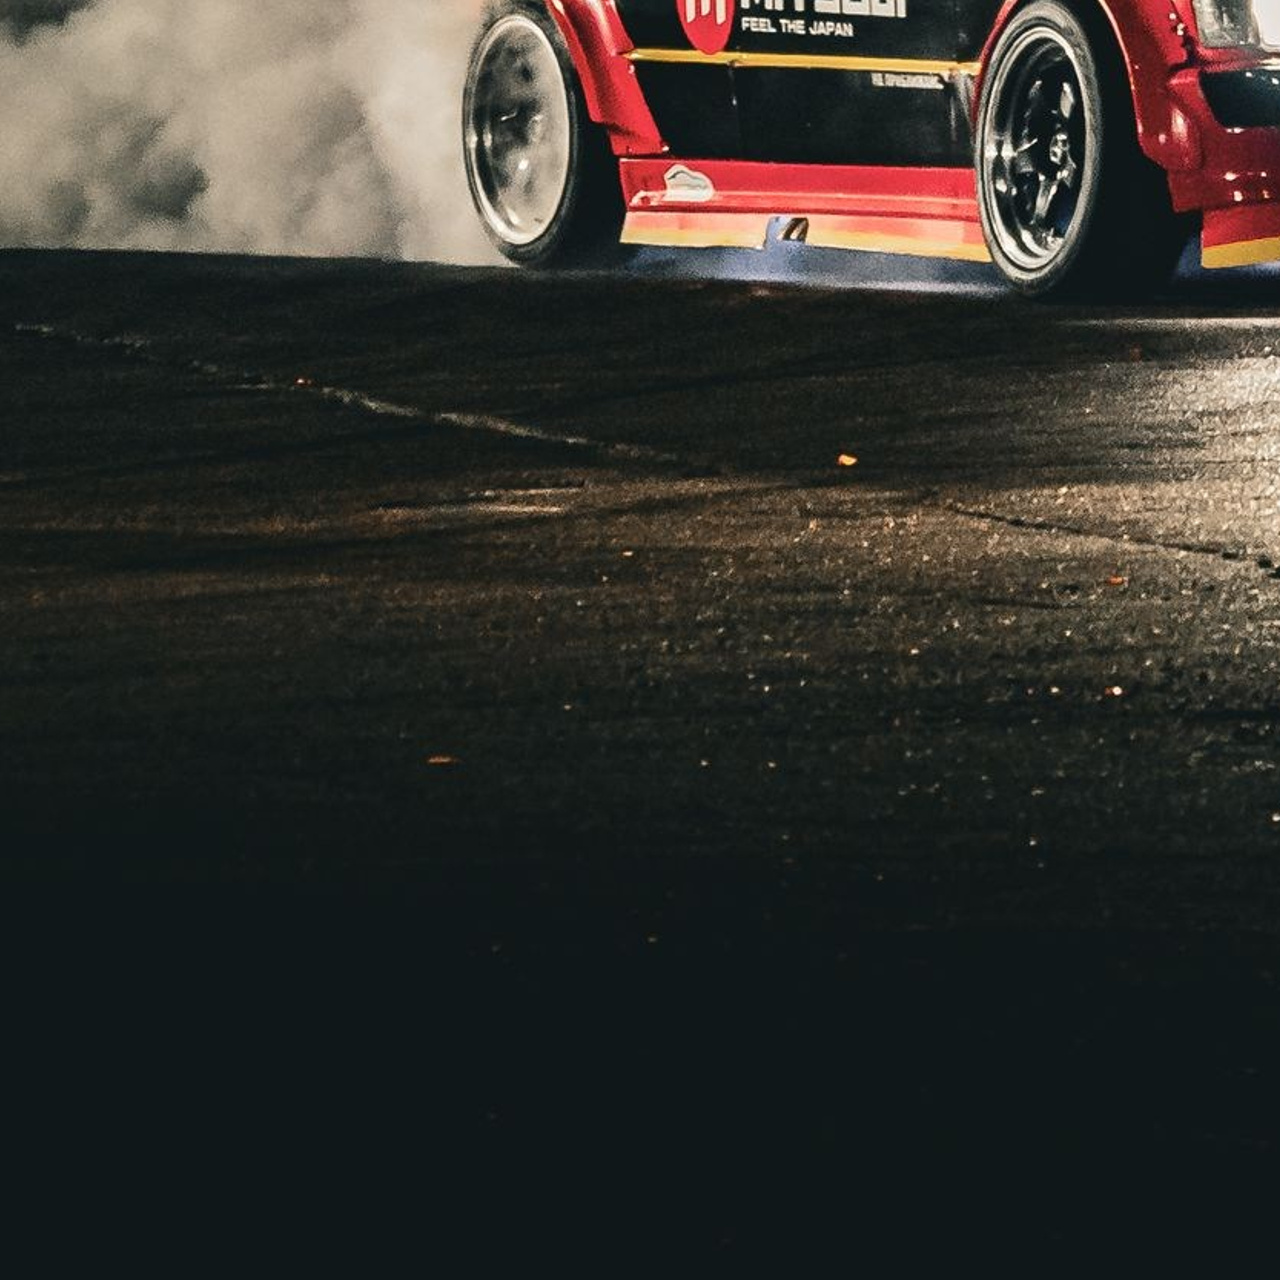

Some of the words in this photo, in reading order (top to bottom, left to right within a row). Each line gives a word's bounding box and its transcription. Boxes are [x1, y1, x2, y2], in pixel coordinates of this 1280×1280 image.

[741, 17, 777, 34] FEEL
[779, 19, 806, 35] THE
[809, 20, 854, 38] JAPAN
